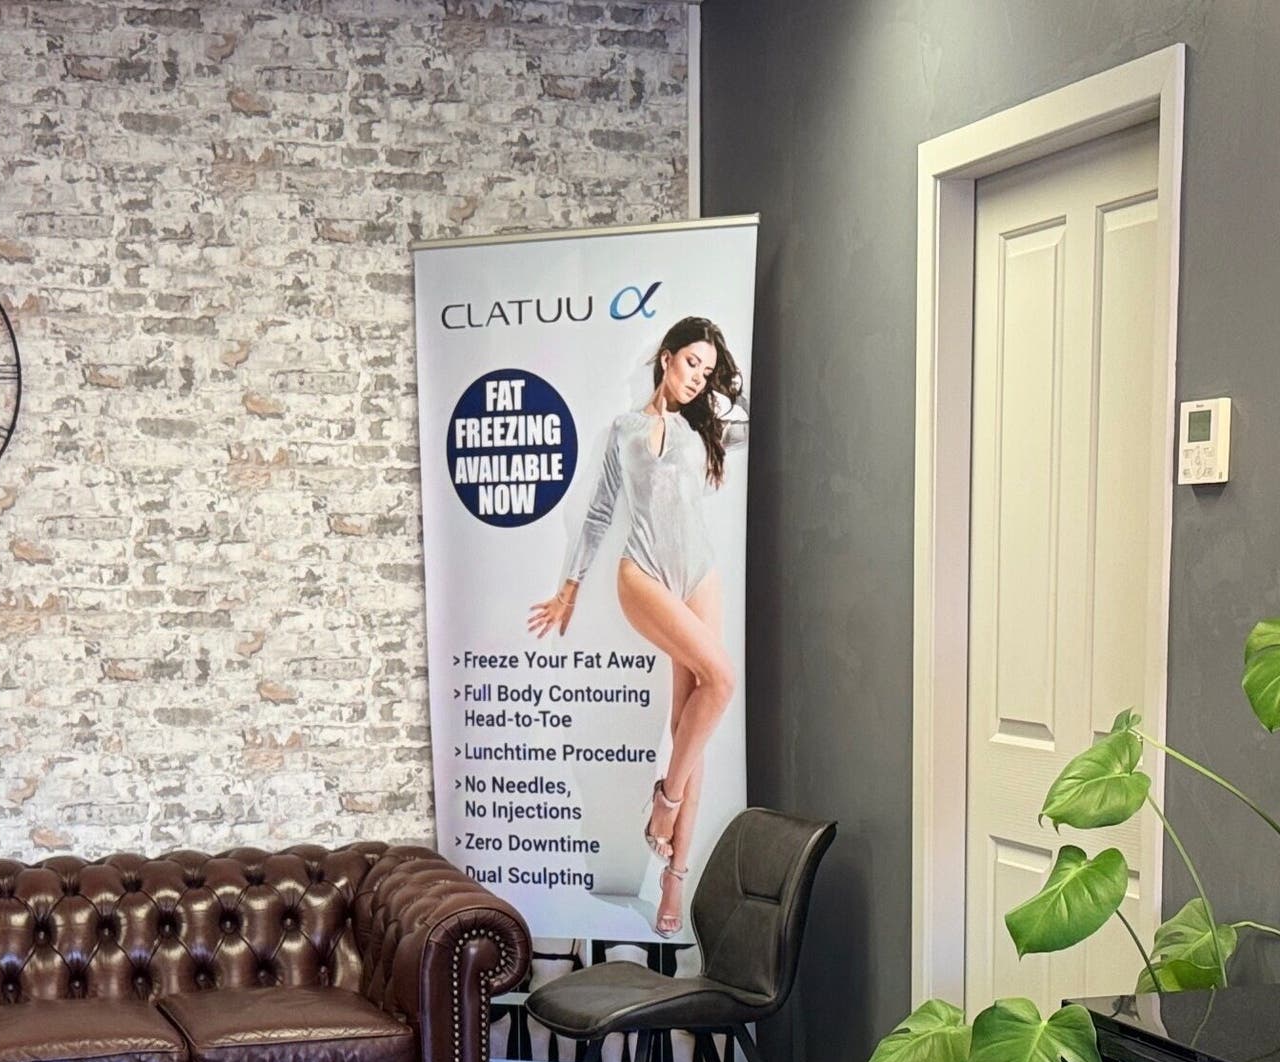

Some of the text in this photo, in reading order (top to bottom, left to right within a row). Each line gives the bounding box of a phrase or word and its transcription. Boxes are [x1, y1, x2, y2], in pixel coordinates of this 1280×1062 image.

[441, 296, 594, 329] CLATUU
[485, 379, 525, 412] FAT
[455, 414, 562, 449] FREEZING
[455, 453, 563, 484] AVAILABLE
[478, 484, 536, 515] NOW
[464, 651, 656, 674] Freeze Your Fat Away
[464, 684, 651, 708] Full Body Contouring
[464, 709, 572, 728] Head-to-Toe
[464, 743, 656, 763] Lunchtime Procedure
[465, 775, 572, 798] No Needles,
[465, 800, 582, 823] No Injections
[465, 833, 601, 853] Zero Downtime
[465, 865, 594, 891] Dual Sculpting
